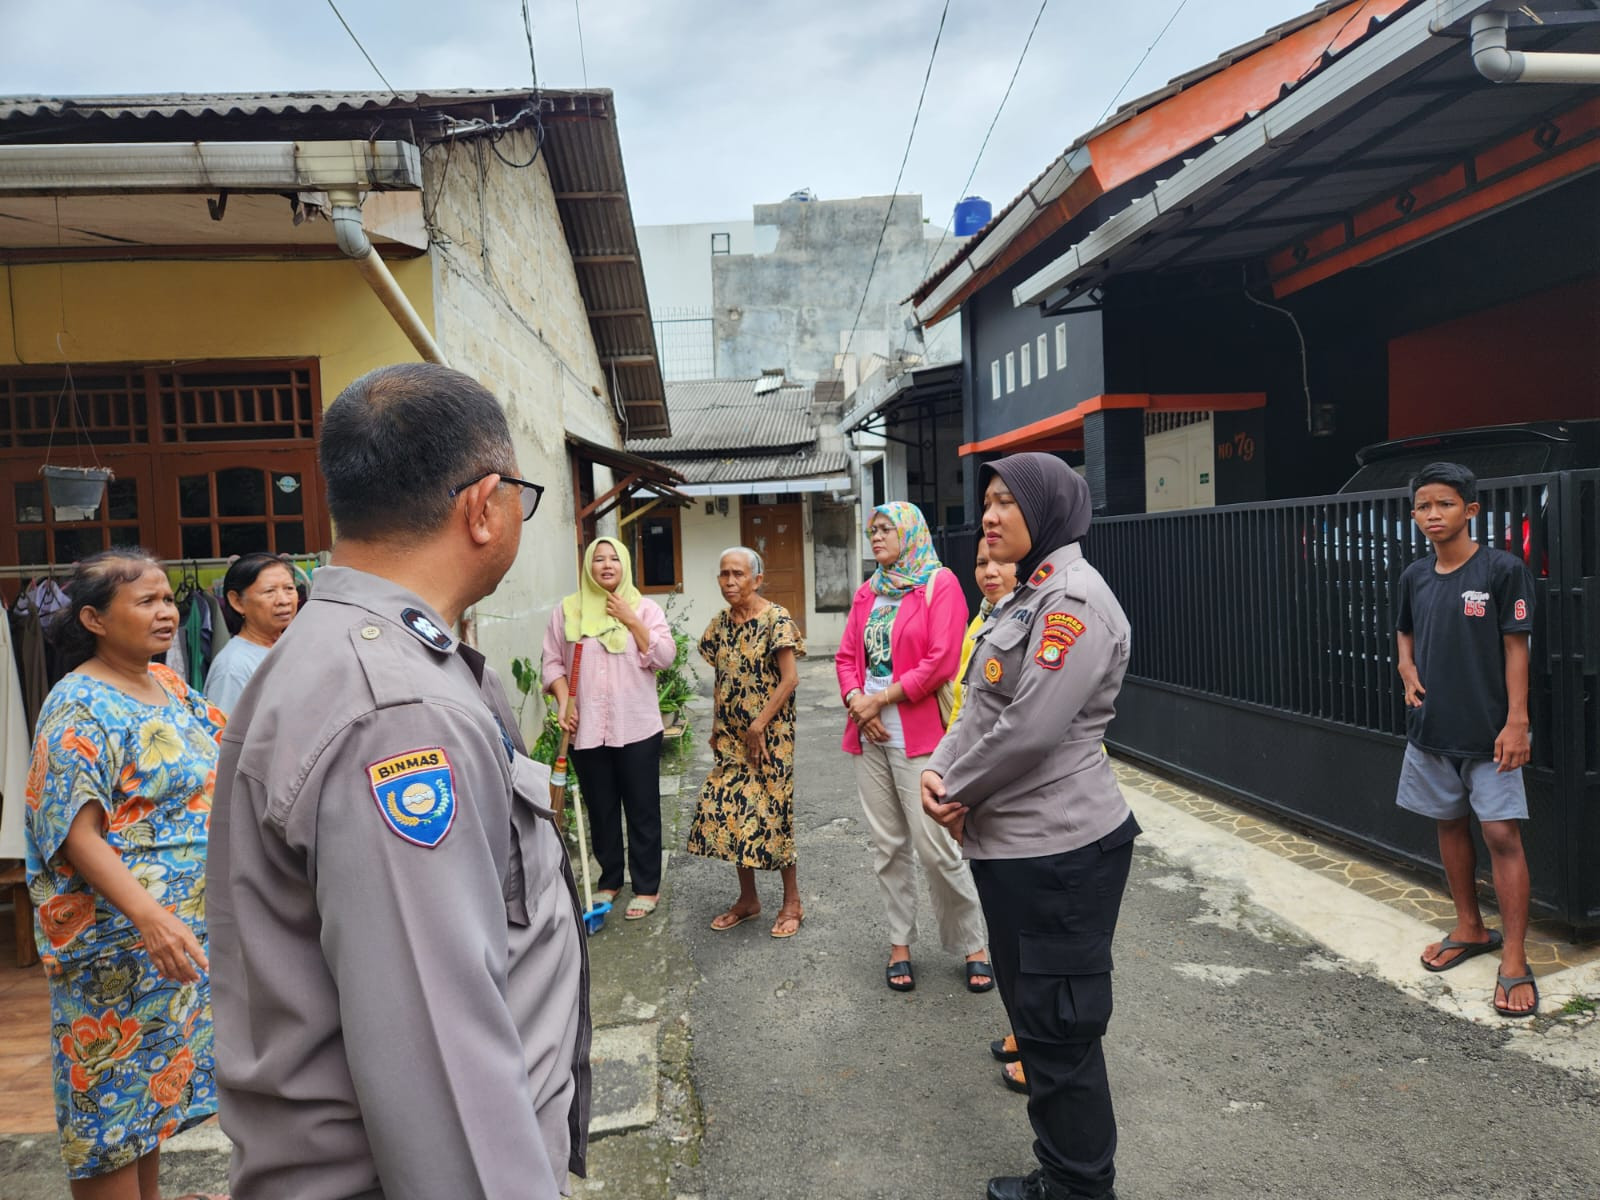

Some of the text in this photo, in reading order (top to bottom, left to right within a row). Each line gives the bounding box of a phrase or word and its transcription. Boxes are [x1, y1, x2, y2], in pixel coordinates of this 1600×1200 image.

[1464, 601, 1486, 617] 65
[1515, 599, 1527, 620] 6
[1047, 613, 1084, 631] POLRES
[378, 753, 440, 778] BINMAS
